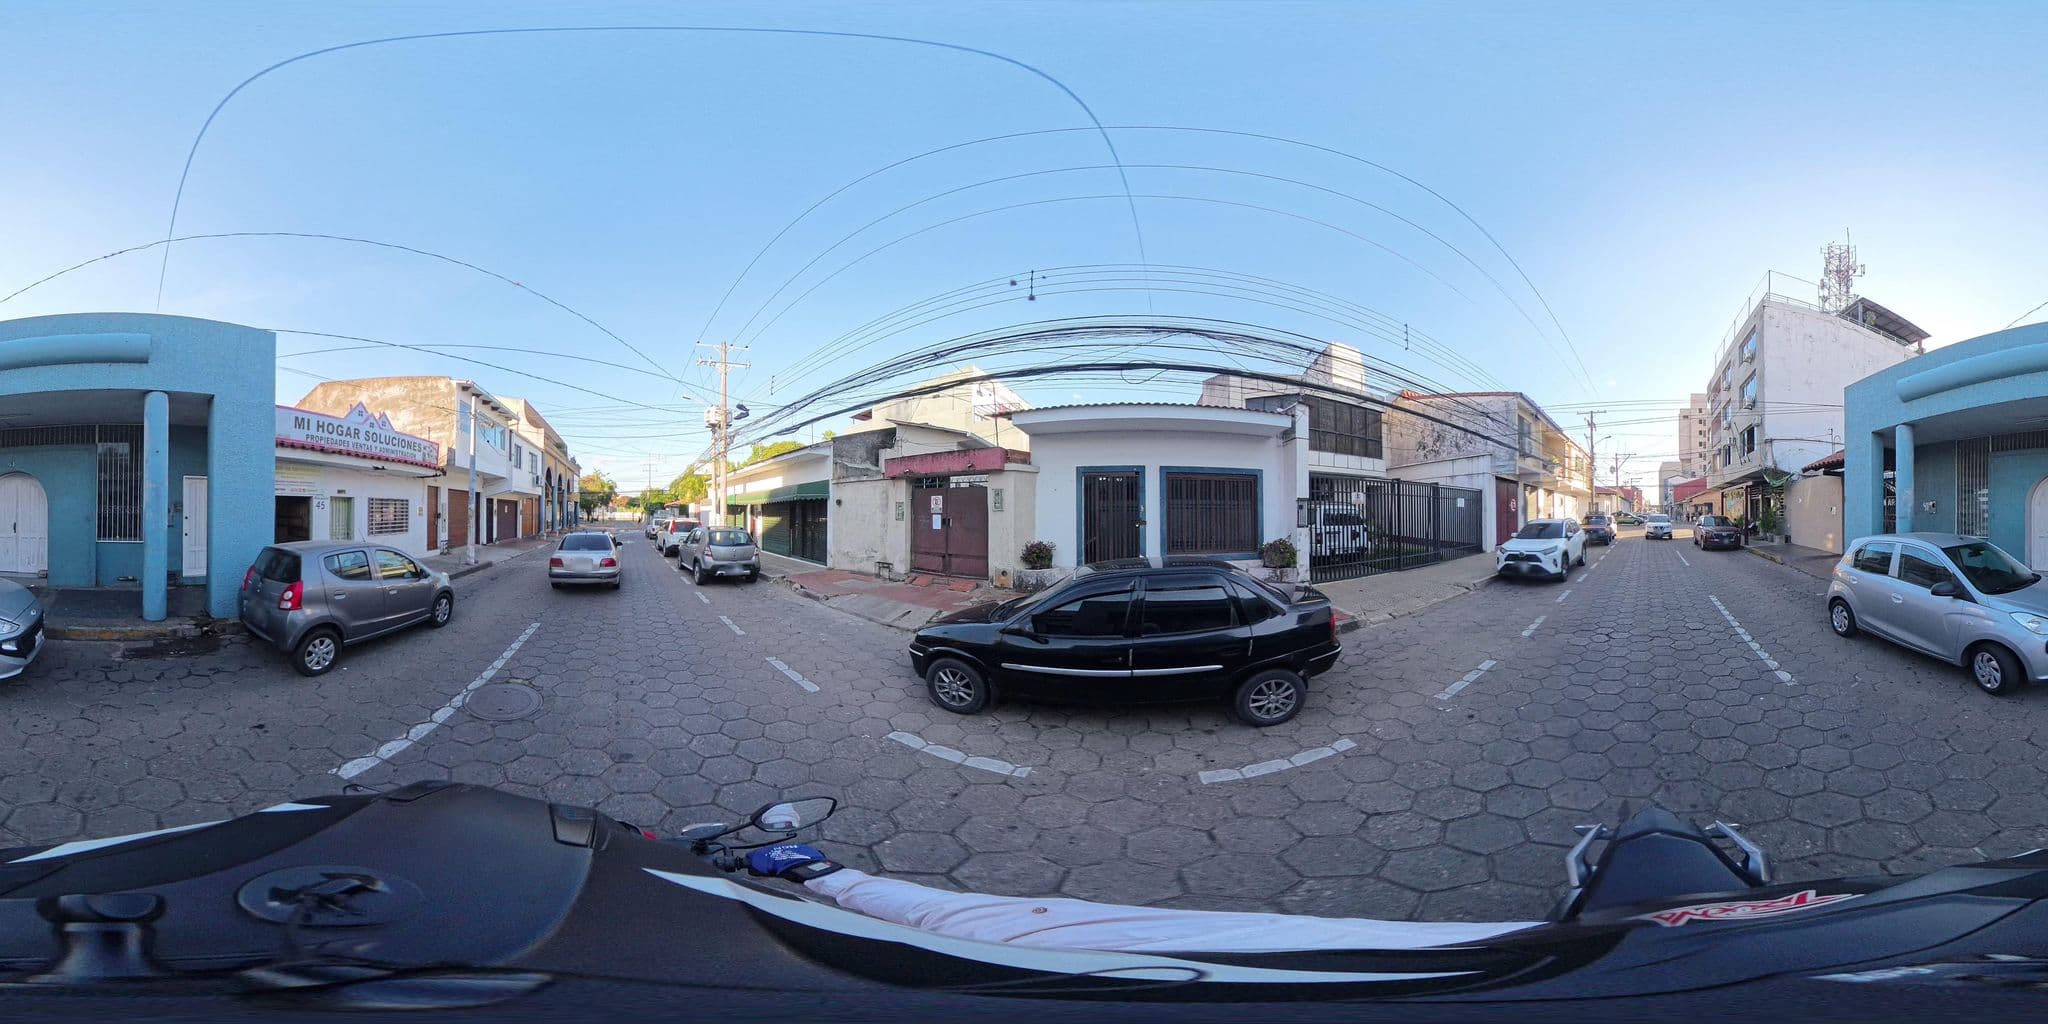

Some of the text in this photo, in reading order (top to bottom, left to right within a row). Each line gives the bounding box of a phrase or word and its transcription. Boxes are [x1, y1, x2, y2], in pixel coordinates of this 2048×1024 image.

[294, 415, 311, 431] MI
[316, 420, 360, 440] HOGAR
[364, 430, 422, 453] SOLUCIONES
[305, 433, 350, 448] PROPIEDADES
[351, 441, 373, 452] VENTAS
[315, 500, 326, 510] 45
